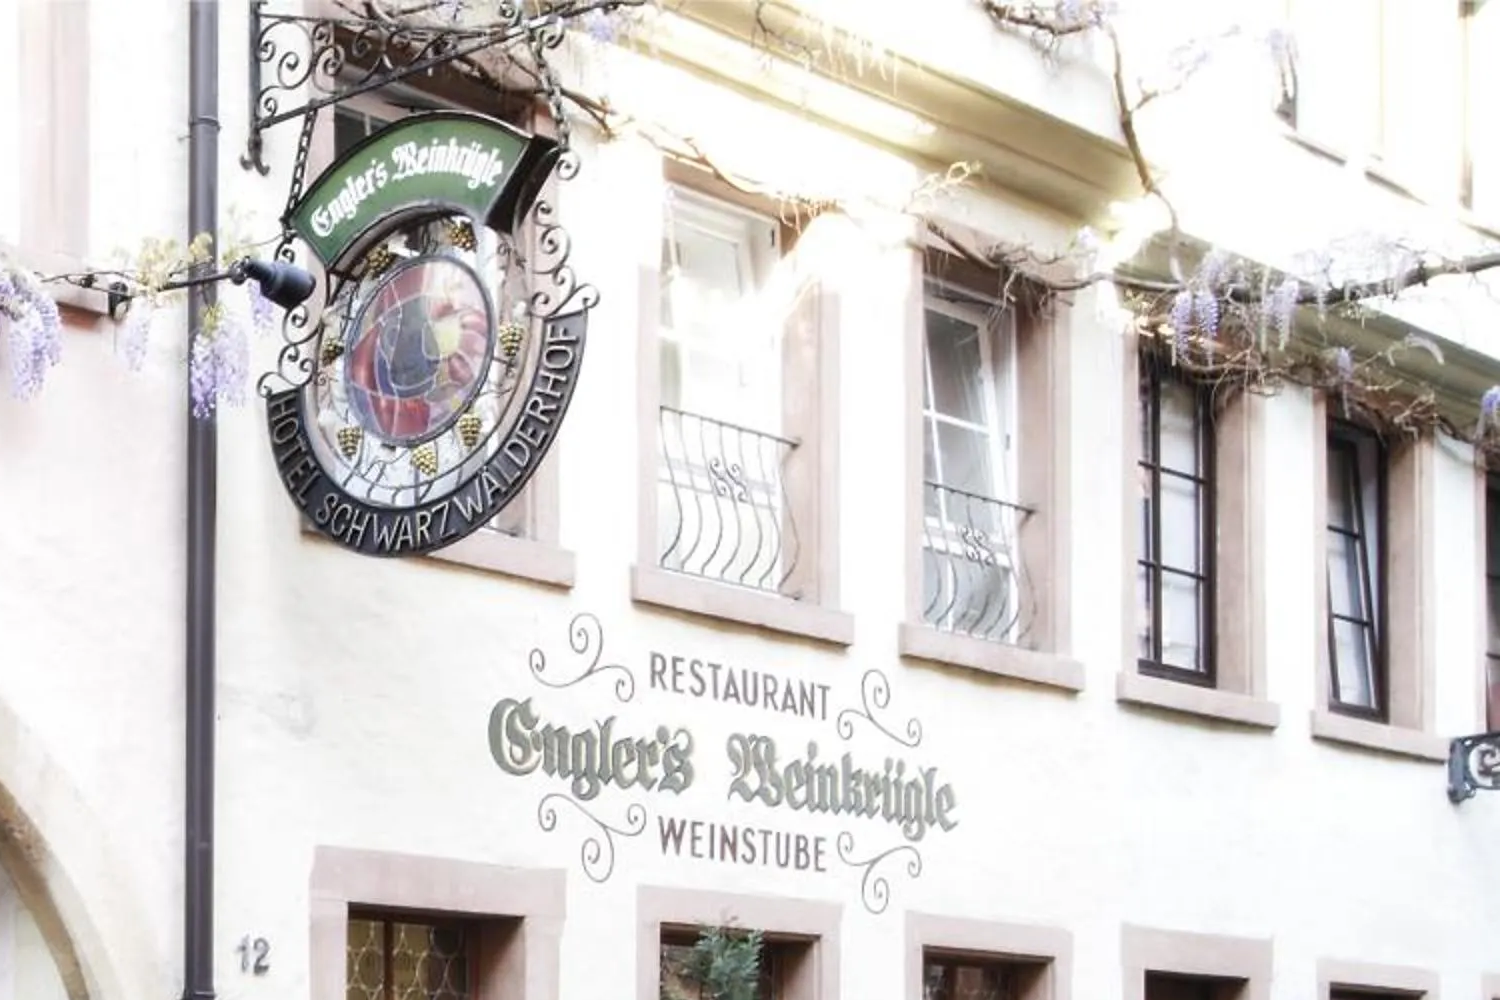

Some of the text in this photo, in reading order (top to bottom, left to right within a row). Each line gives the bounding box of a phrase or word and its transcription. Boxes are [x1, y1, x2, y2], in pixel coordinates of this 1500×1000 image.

[310, 136, 504, 237] Engler's Weinkrügle
[269, 323, 581, 550] HOTEL SCHWARZWÄLDERHOF
[649, 650, 832, 721] RESTAURANT
[487, 696, 960, 843] Engler's Weinkrügle
[657, 815, 829, 873] WEINSTUBE
[235, 933, 271, 976] 12
